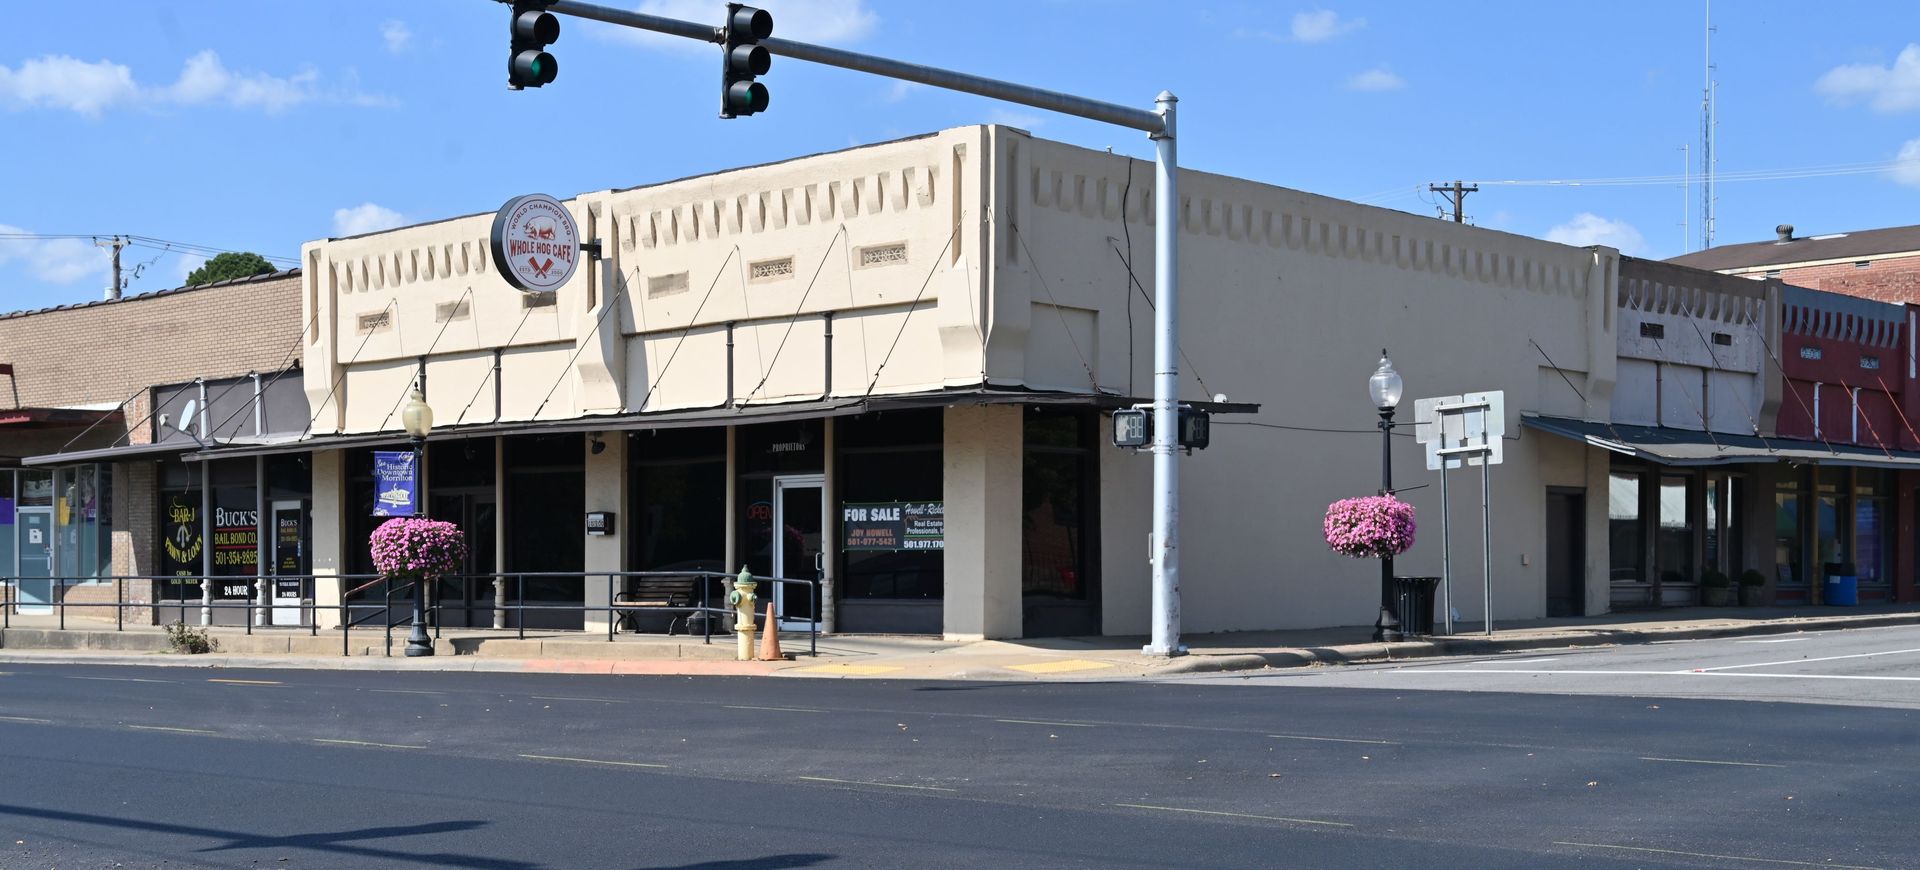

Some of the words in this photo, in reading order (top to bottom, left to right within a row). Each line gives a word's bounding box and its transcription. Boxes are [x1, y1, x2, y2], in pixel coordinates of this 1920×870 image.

[511, 208, 528, 230] WORLD
[529, 204, 563, 219] CHAMPION
[510, 239, 535, 257] WHOLE
[536, 242, 551, 255] HOG
[552, 244, 571, 264] CAFE
[772, 442, 806, 453] PROPRIETORS
[174, 507, 195, 522] BAR-J
[216, 507, 258, 527] BUCK'S
[844, 508, 867, 521] FOR
[870, 507, 900, 521] SALE
[214, 533, 230, 545] BAIL
[230, 532, 246, 544] BOND
[247, 532, 258, 544] CO.
[851, 528, 865, 537] JOY
[866, 528, 894, 537] HOWELL
[903, 540, 944, 549] 501.977.170
[181, 550, 187, 563] &
[224, 586, 232, 596] 24
[233, 585, 249, 596] HOUR
